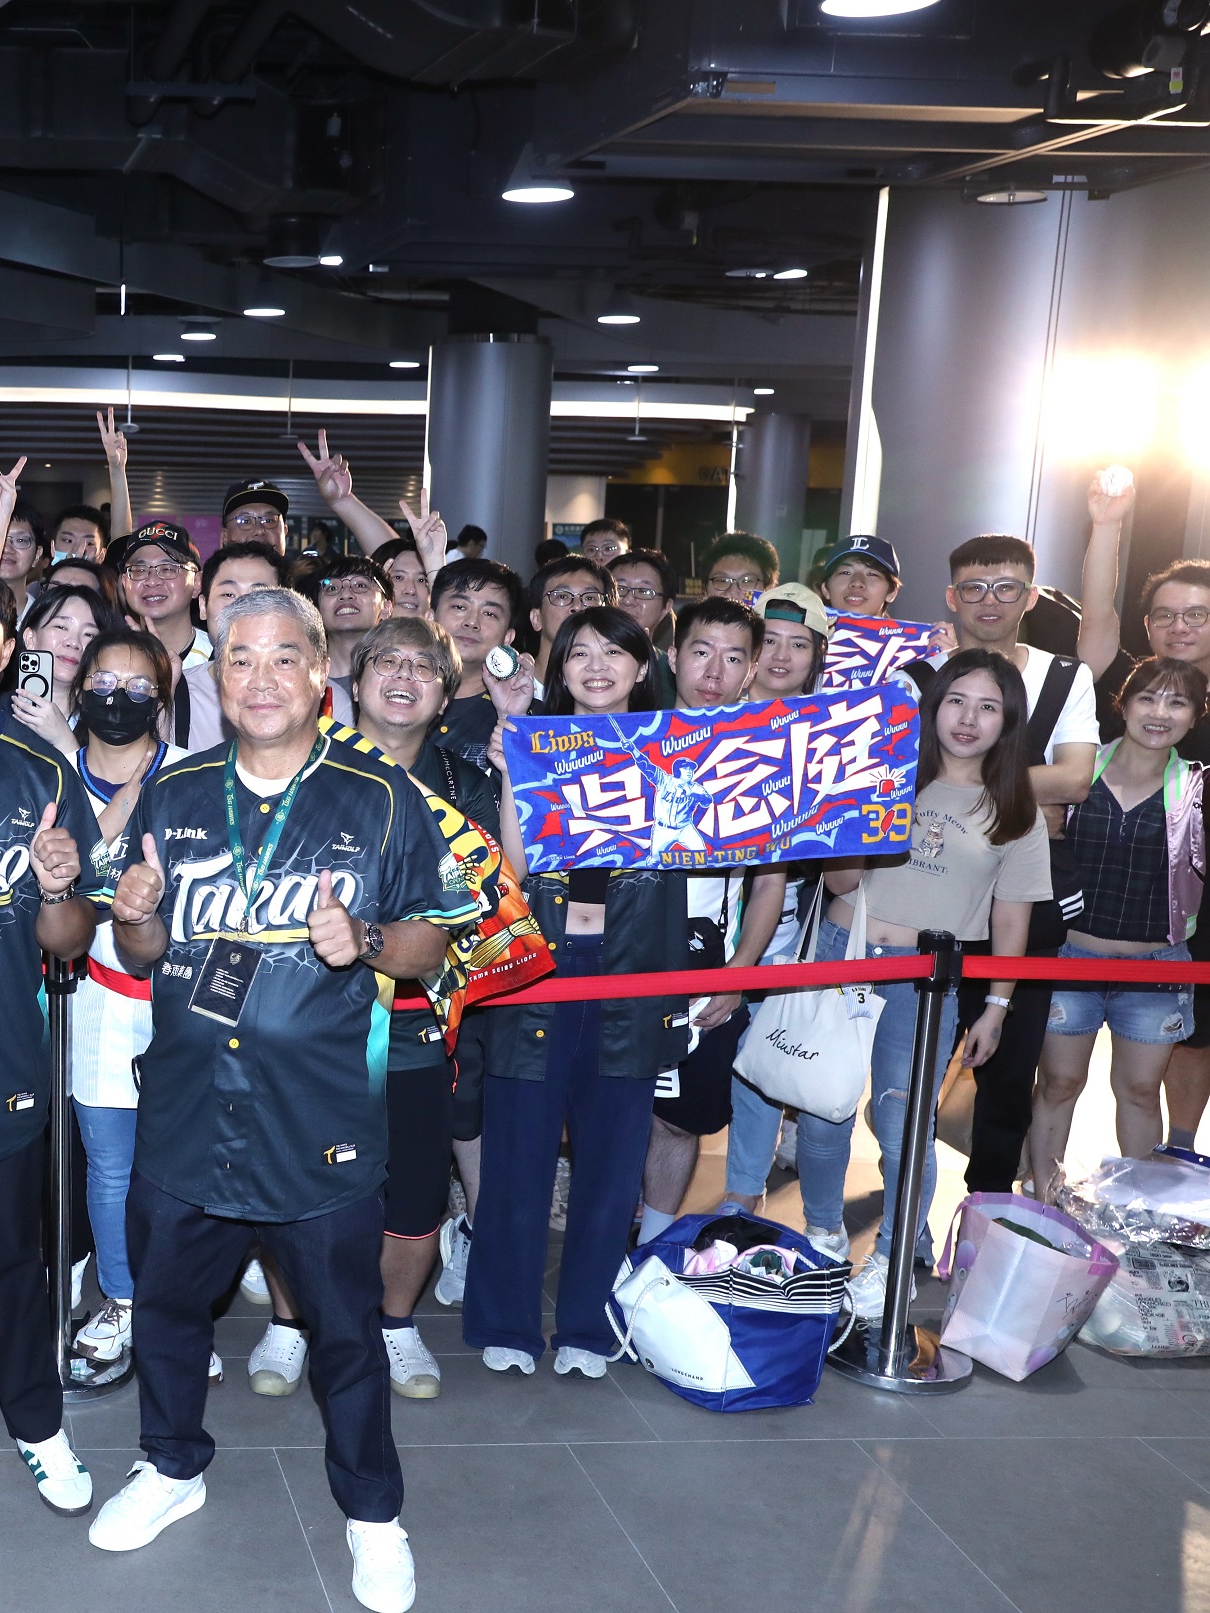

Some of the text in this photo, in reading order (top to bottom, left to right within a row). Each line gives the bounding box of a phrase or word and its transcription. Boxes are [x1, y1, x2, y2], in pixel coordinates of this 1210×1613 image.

[138, 526, 178, 541] GUCCI
[529, 729, 595, 754] Lions
[861, 802, 912, 844] 39
[942, 813, 968, 835] Meow
[662, 847, 758, 865] NIEN-TING
[908, 858, 947, 874] IBRANT
[857, 992, 865, 1004] 3
